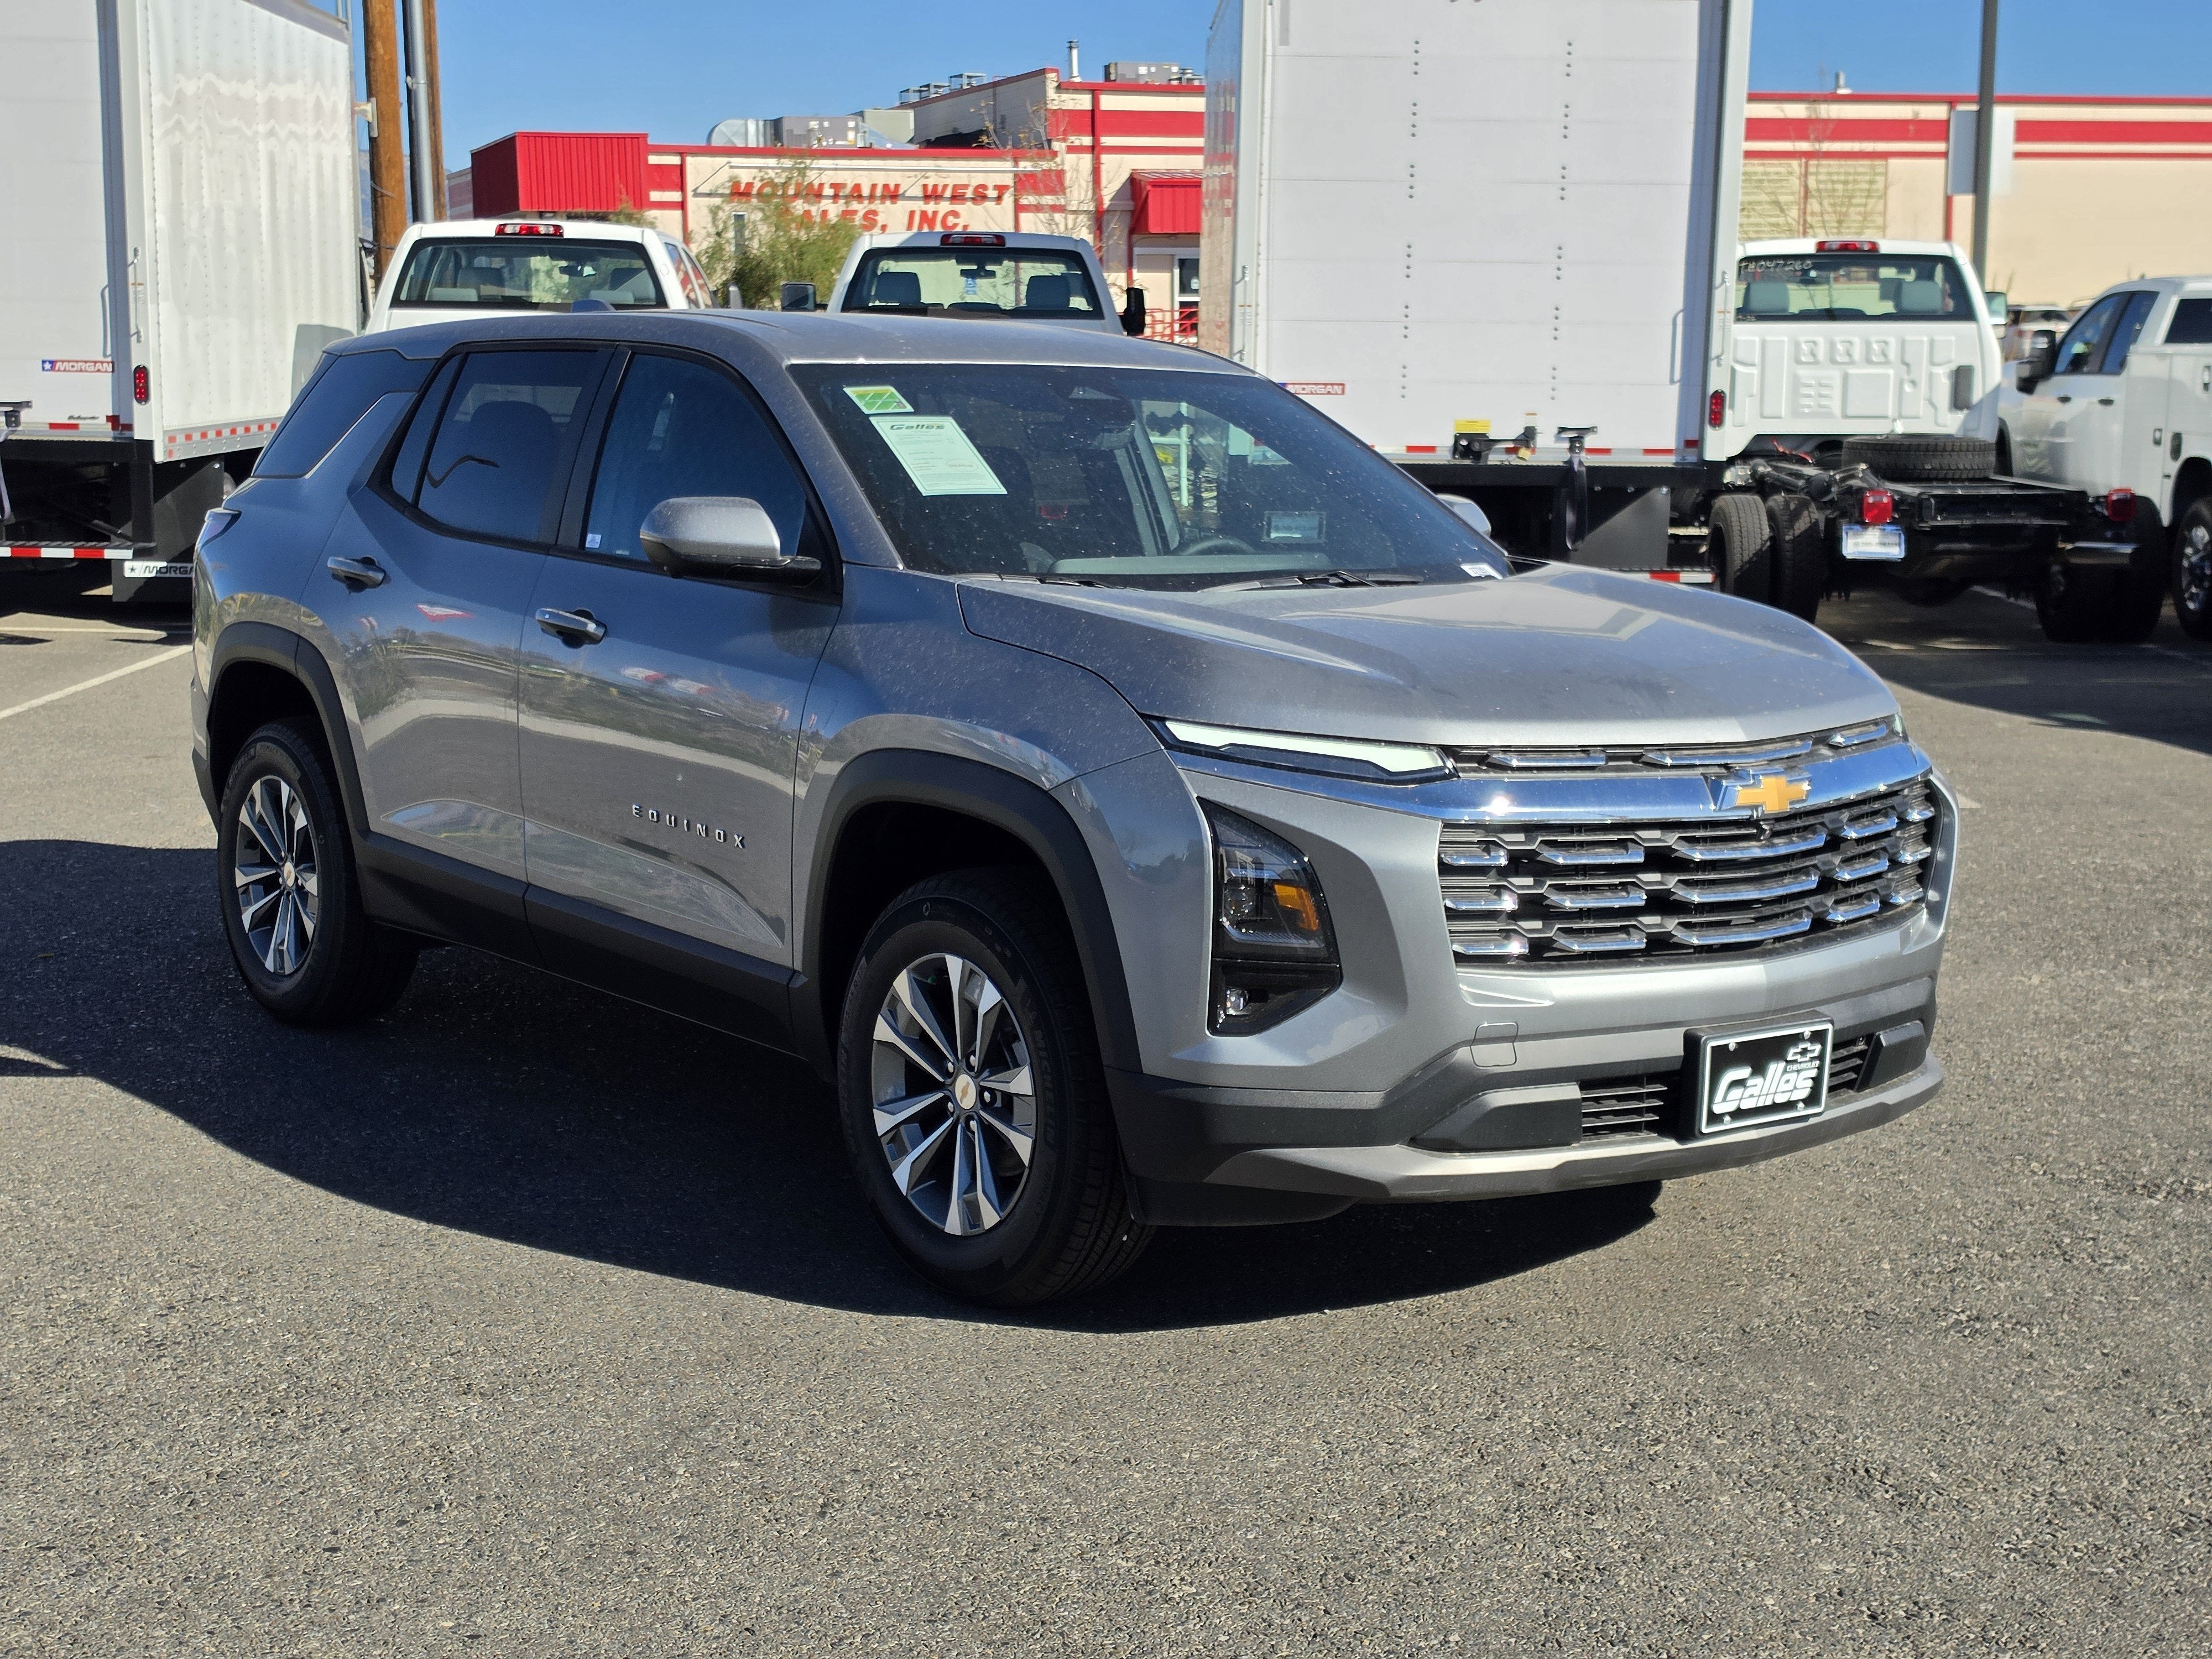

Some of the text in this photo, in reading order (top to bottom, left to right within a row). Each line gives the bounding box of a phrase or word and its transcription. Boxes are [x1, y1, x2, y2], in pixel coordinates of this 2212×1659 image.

[729, 181, 1010, 205] MOUNTAIN WEST
[55, 361, 112, 372] MORGAN
[1287, 384, 1343, 394] MORGAN
[632, 804, 744, 849] EQUINOX
[1787, 1060, 1820, 1072] CHEVROLET
[1712, 1061, 1818, 1114] Galles
